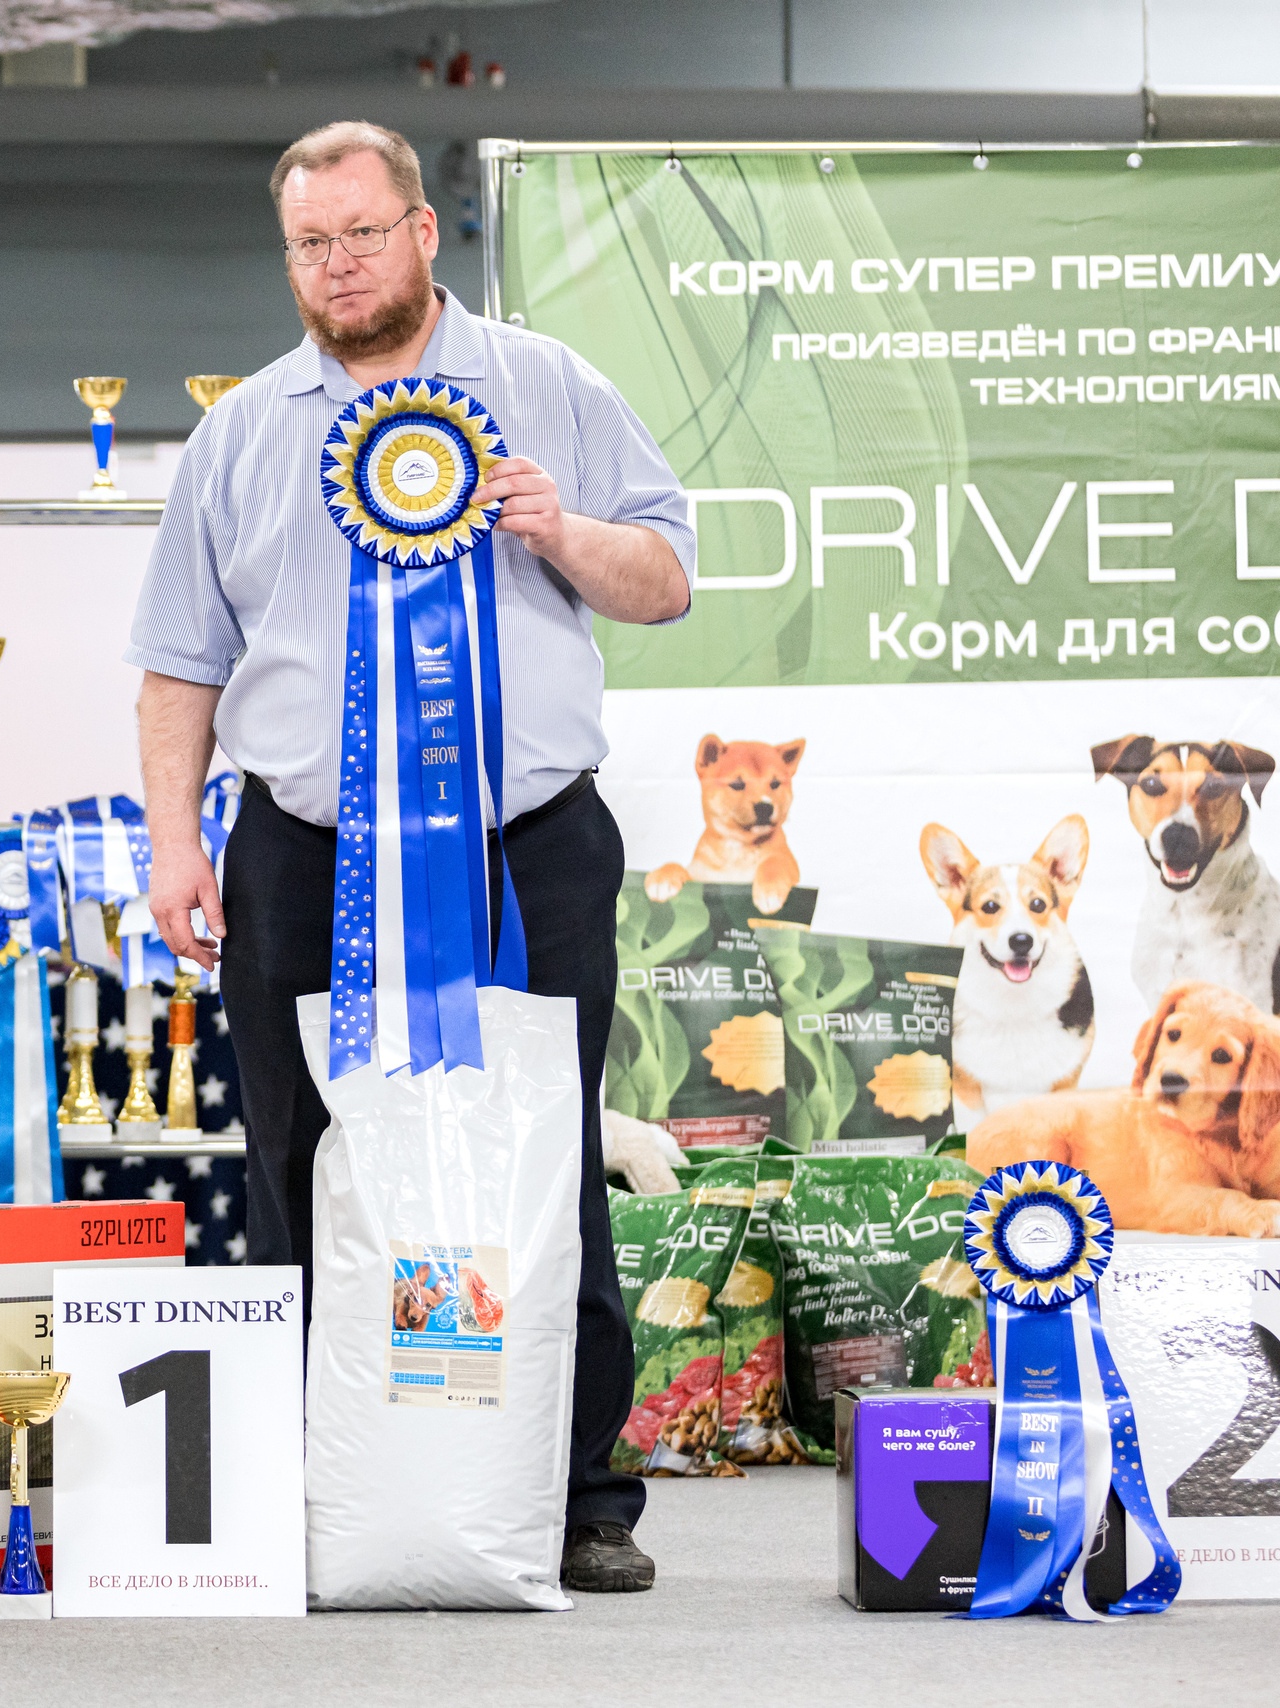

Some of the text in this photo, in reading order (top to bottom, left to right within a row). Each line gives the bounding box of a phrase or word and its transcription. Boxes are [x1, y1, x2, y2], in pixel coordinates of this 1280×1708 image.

[669, 253, 1280, 296] КОРМ СУПЕР ПРЕМИУ
[772, 324, 1280, 363] ПРОИЗВЕДЁН ПО ФРАН
[686, 480, 1176, 590] DRIVE
[869, 609, 1280, 670] Корм для со
[420, 699, 455, 719] BEST
[432, 726, 445, 739] IN
[422, 746, 459, 766] SHOW
[437, 781, 448, 800] I
[619, 966, 734, 990] DRIVE
[798, 1012, 950, 1036] DRIVE DOG
[814, 1141, 887, 1153] Mini holistic
[81, 1218, 166, 1247] 32PL12TC
[771, 1221, 895, 1248] DRIVE
[62, 1300, 286, 1323] BEST DINNER
[1020, 1412, 1059, 1432] BEST
[1159, 1316, 1280, 1517] 2
[882, 1427, 960, 1440] Я вам сушу,
[118, 1350, 212, 1544] 1
[882, 1440, 976, 1451] чего же боле?
[1030, 1440, 1045, 1453] IN
[1016, 1460, 1059, 1480] SHOW
[1027, 1496, 1045, 1516] II
[1190, 1548, 1236, 1564] ДЕЛО
[1241, 1548, 1251, 1561] В
[88, 1575, 121, 1588] ВСЕ
[124, 1575, 173, 1590] ДЕЛО
[177, 1575, 189, 1588] В
[939, 1575, 977, 1585] Сушилка
